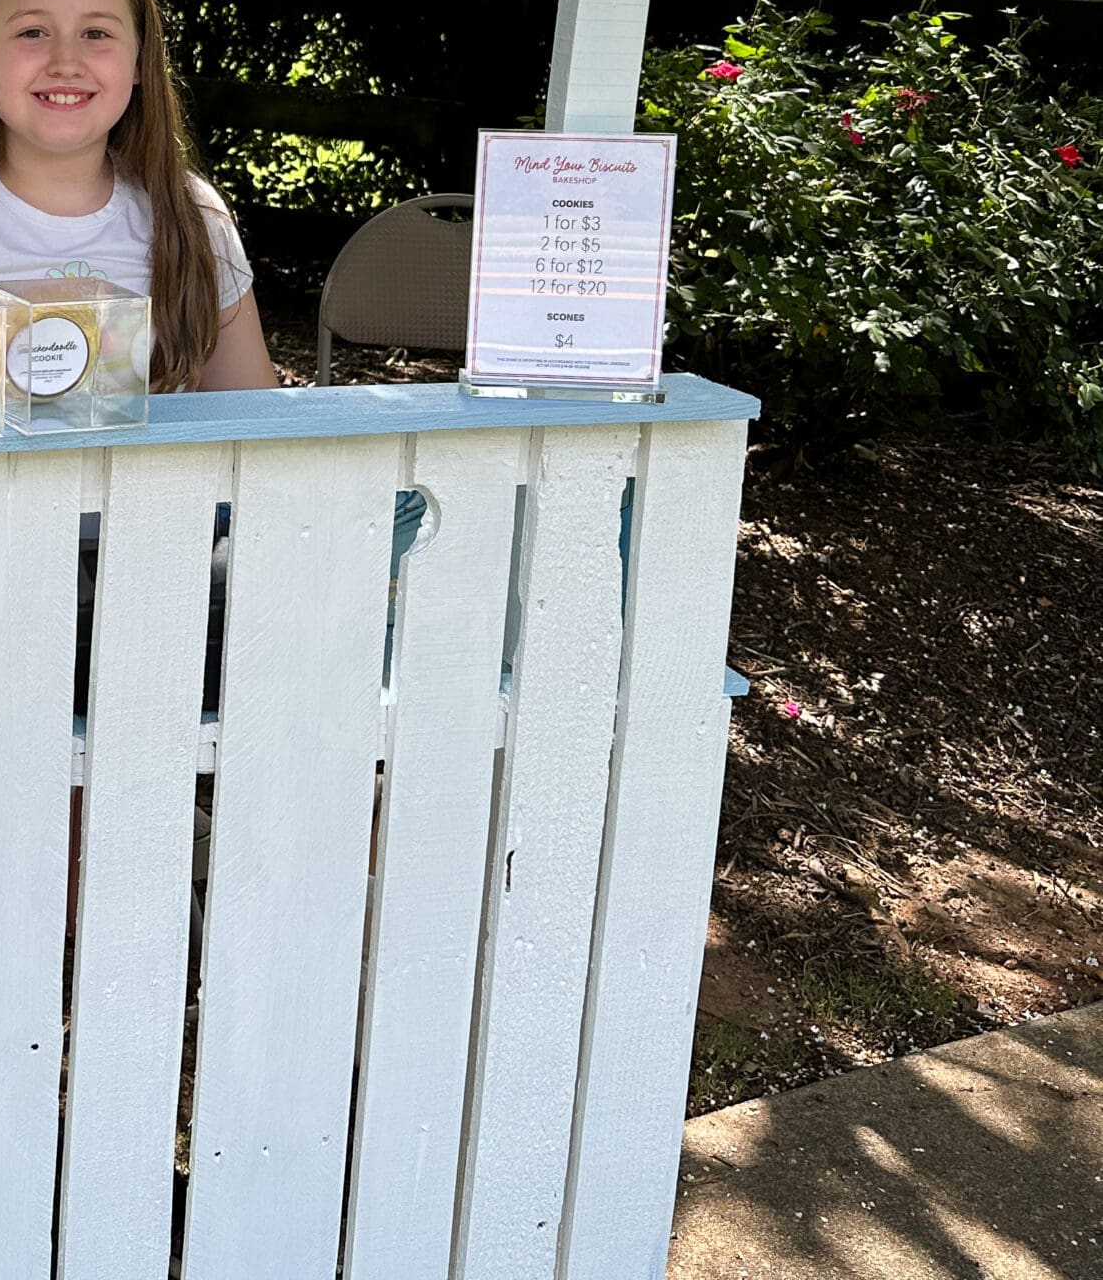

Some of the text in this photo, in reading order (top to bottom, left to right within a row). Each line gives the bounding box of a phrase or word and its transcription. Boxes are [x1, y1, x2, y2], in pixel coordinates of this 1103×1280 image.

[514, 156, 638, 175] Mind Your Biscuits
[552, 176, 597, 184] BAKESHOP
[552, 199, 594, 208] COOKIES
[543, 214, 601, 231] 1 for $3
[540, 236, 600, 253] 2 for $5
[535, 257, 603, 274] 6 for $12
[530, 279, 606, 296] 12 for $20
[546, 312, 585, 321] SCONES
[555, 333, 574, 348] $4
[32, 354, 63, 362] COOKIE
